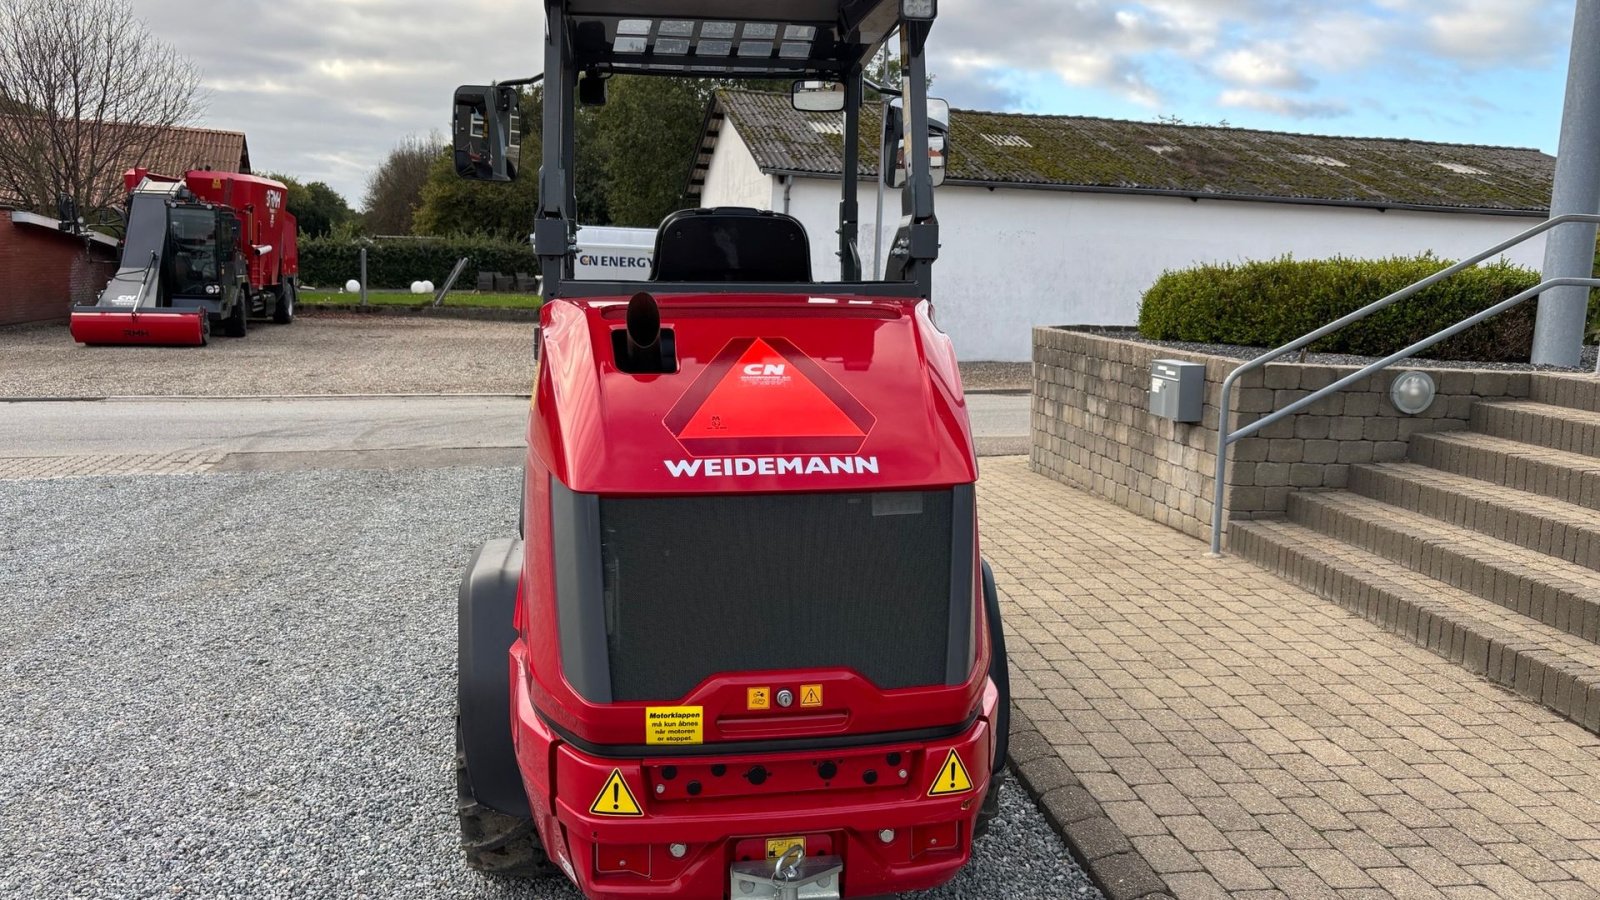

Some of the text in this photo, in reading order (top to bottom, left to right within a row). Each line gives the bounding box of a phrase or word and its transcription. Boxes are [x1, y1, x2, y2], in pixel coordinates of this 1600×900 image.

[580, 255, 598, 266] CN
[743, 363, 785, 375] CN
[664, 456, 879, 477] WEIDEMANN
